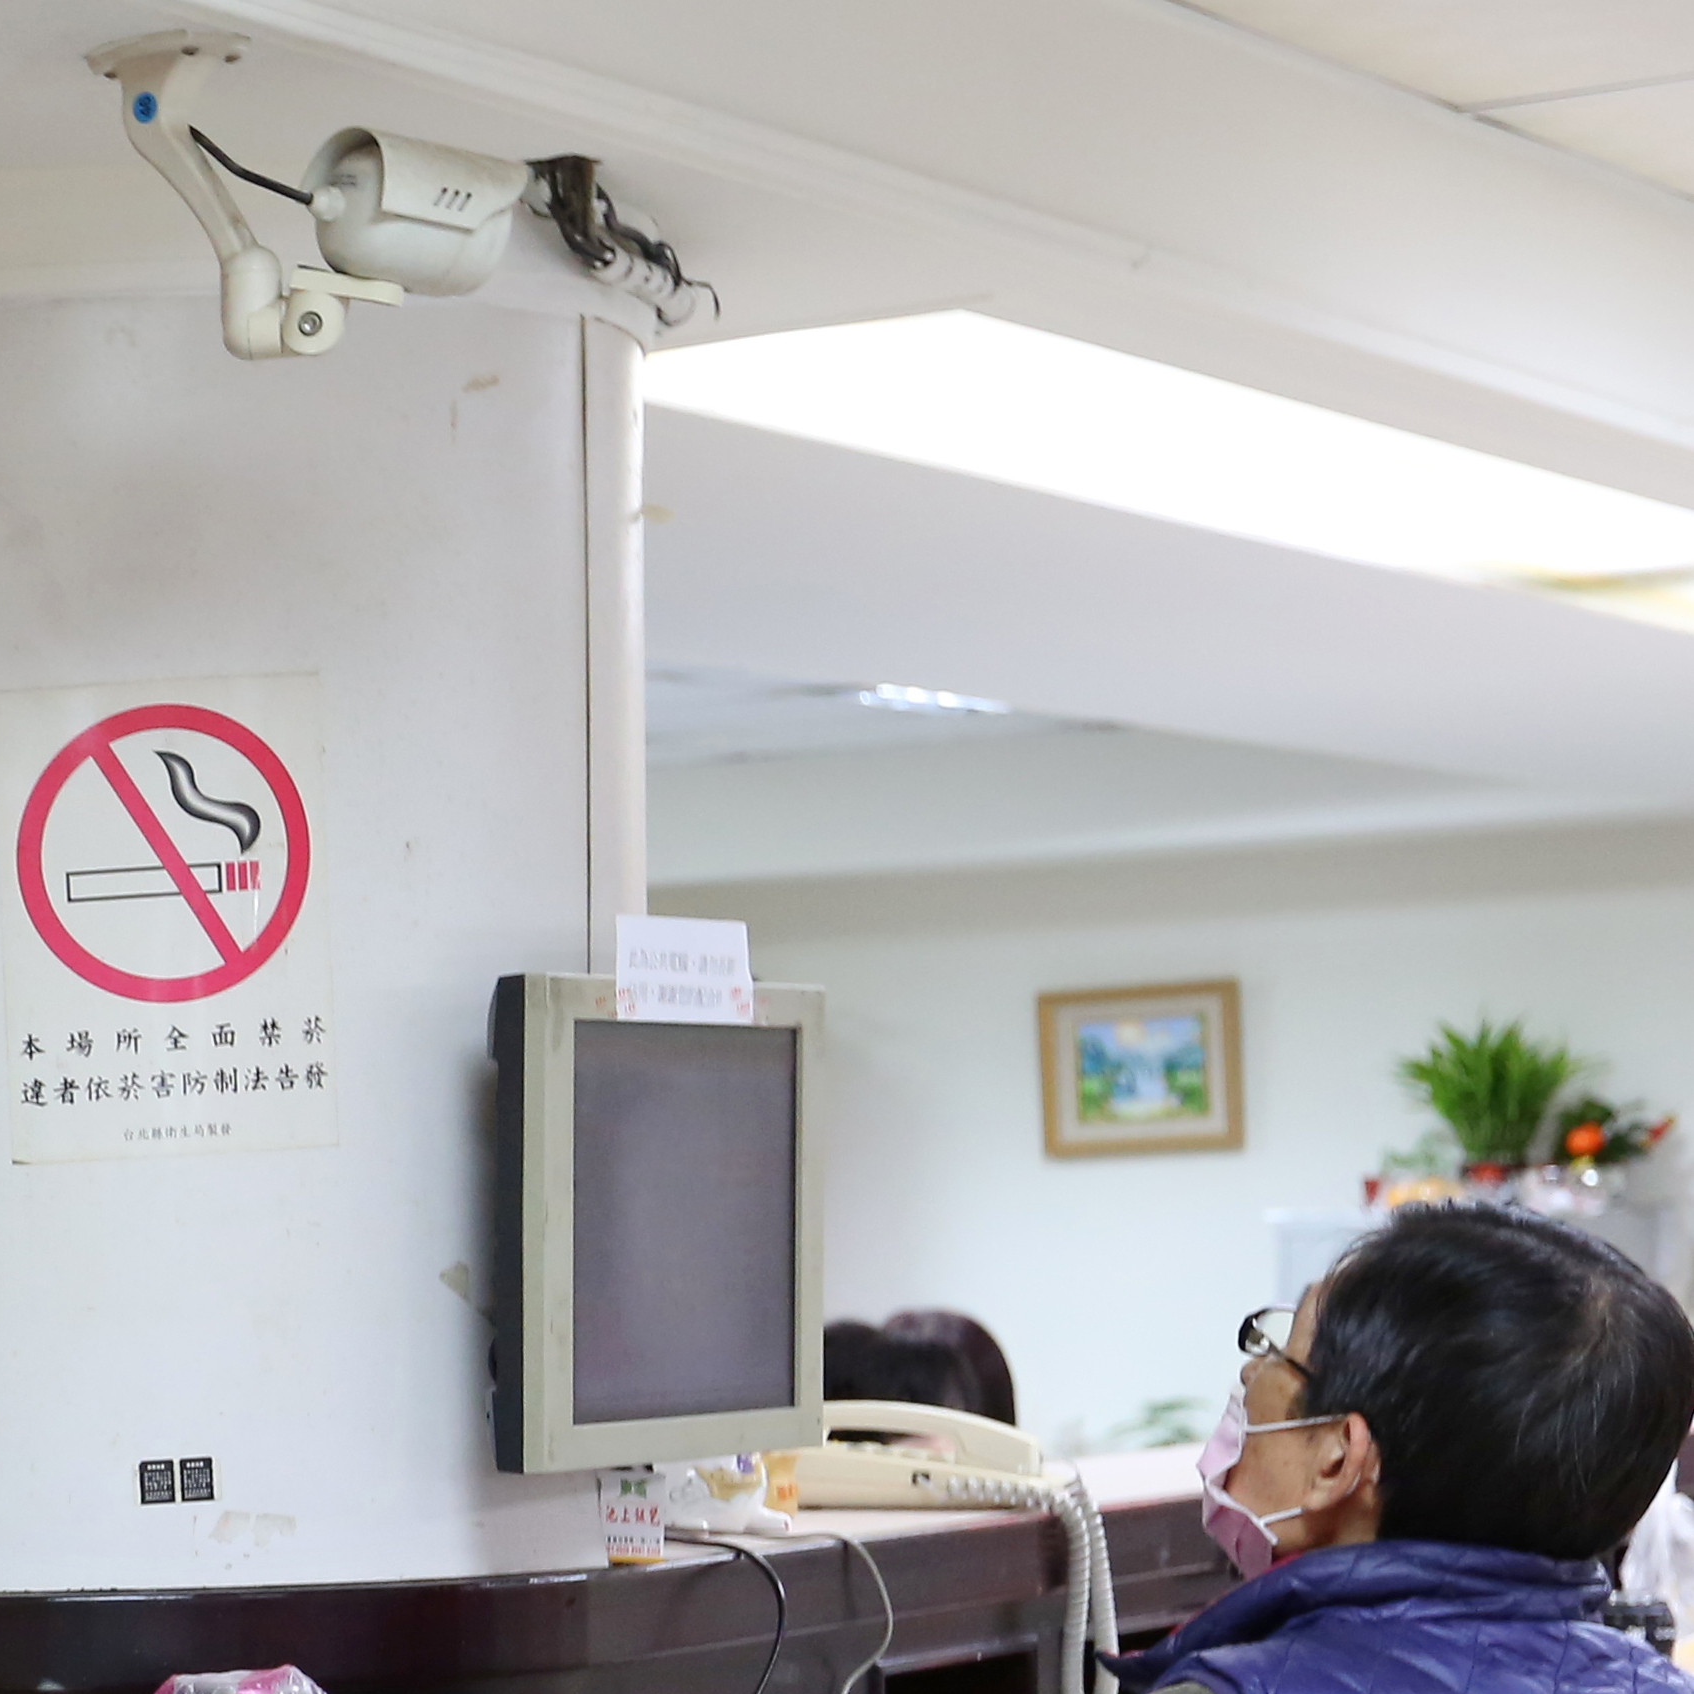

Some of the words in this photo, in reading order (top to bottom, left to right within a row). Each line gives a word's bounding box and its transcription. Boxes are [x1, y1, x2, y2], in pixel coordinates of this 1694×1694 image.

[20, 1015, 328, 1061] 本場所全面禁菸
[21, 1061, 330, 1107] 違者依菸害防制法告發
